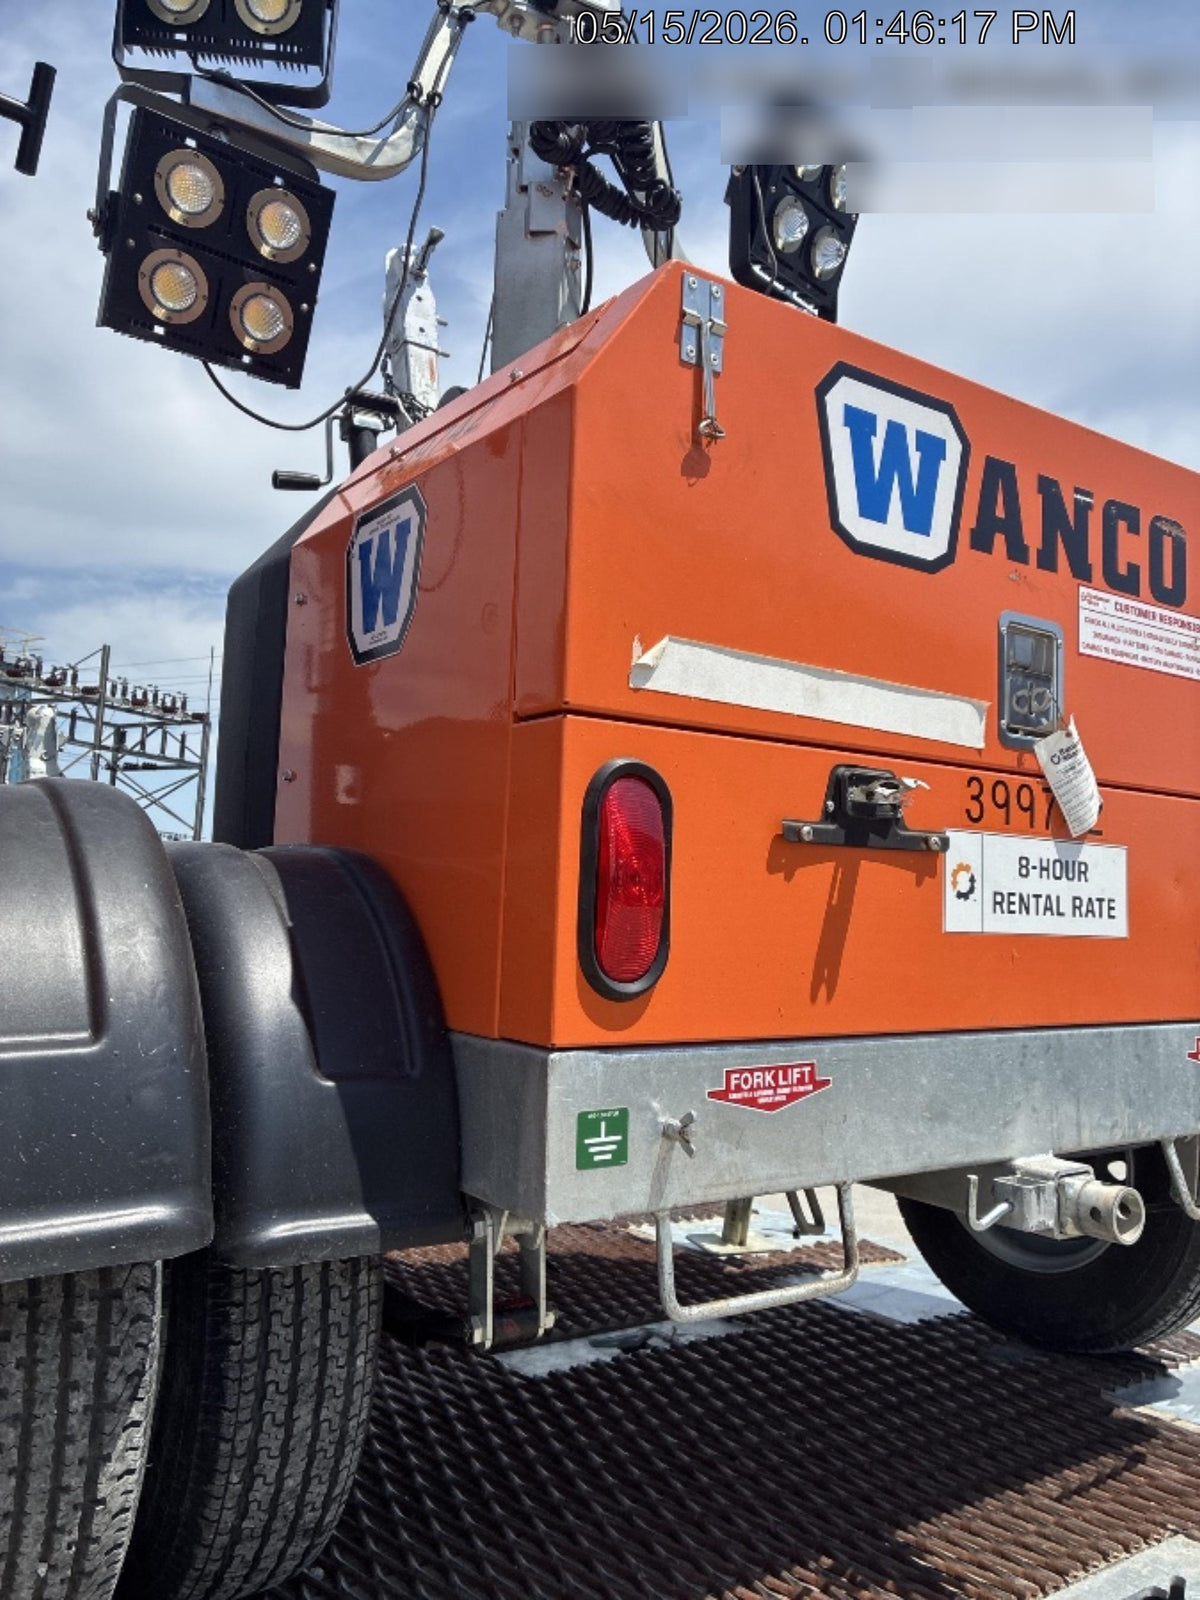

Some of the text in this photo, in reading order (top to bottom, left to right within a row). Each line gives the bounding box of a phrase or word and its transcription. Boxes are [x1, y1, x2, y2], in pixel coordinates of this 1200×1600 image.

[359, 517, 411, 634] W
[1114, 601, 1157, 621] CUSTOMER
[1018, 856, 1089, 882] 8-HOUR
[993, 891, 1116, 919] RENTAL RATE
[730, 1066, 811, 1091] FORK LIFT
